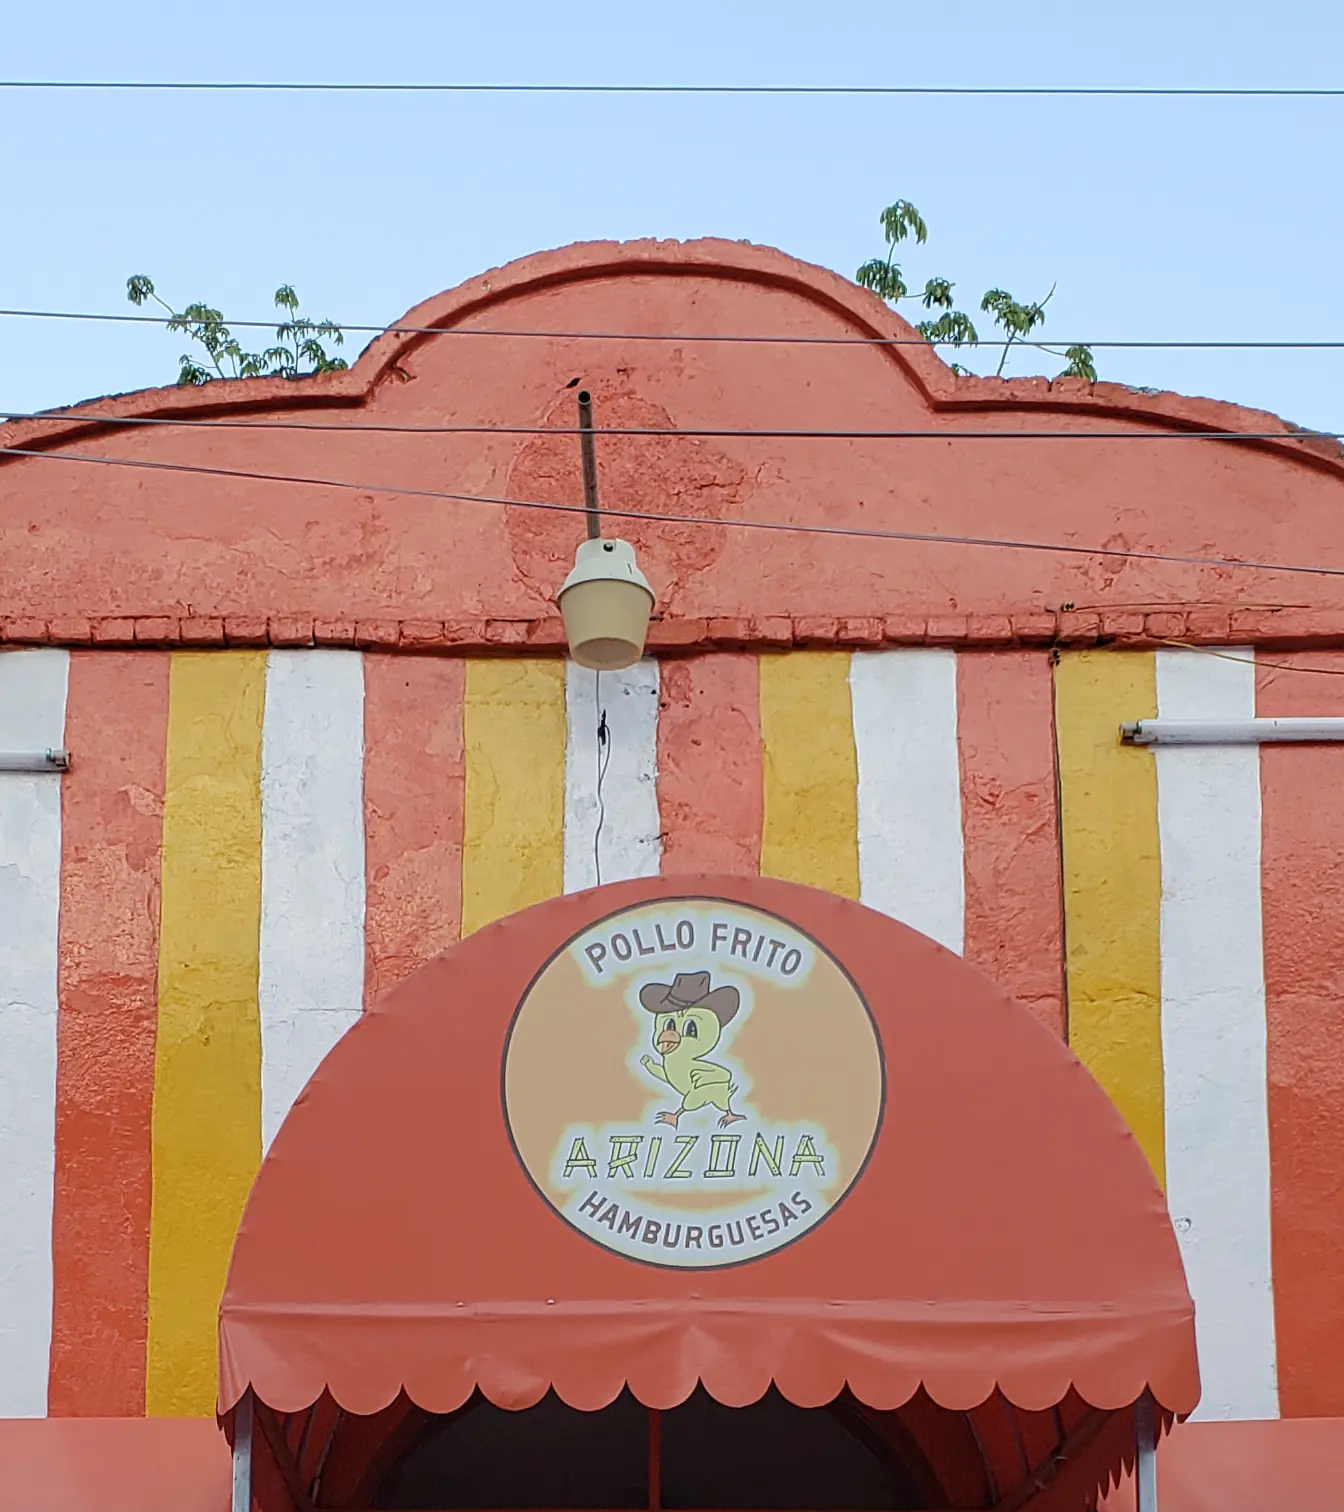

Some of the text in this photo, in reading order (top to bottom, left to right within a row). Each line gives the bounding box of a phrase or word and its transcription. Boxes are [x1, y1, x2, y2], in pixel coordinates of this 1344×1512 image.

[585, 920, 803, 976] POLLO FRITO
[562, 1133, 826, 1179] ARIZONA
[578, 1190, 812, 1250] HAMBURGUESAS
